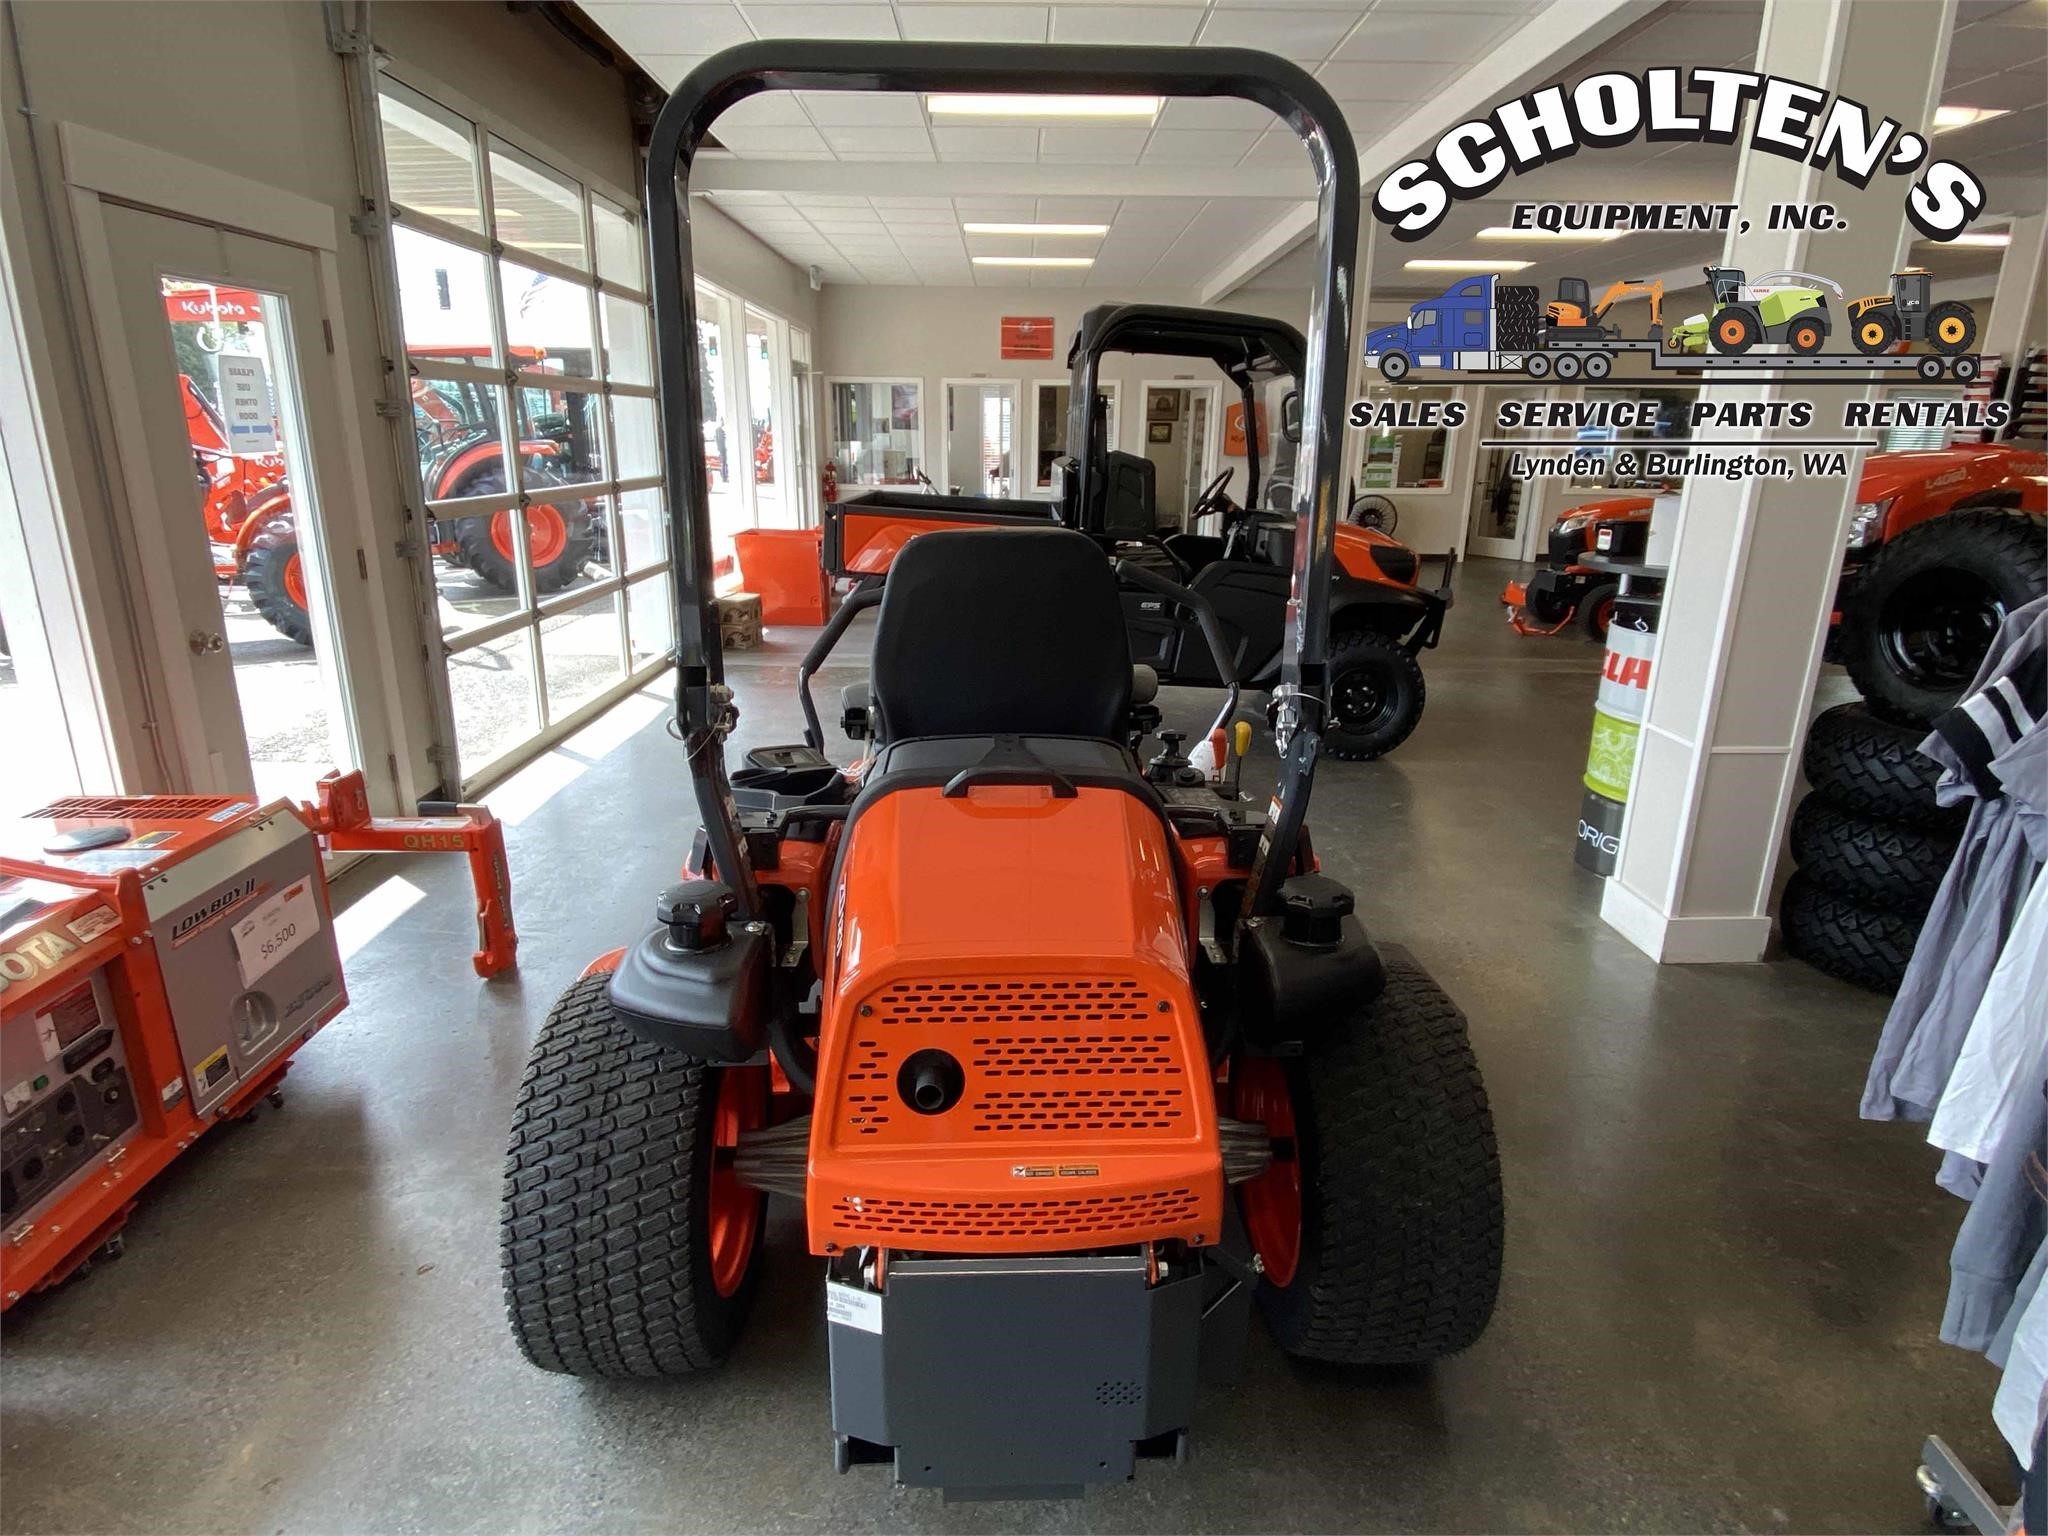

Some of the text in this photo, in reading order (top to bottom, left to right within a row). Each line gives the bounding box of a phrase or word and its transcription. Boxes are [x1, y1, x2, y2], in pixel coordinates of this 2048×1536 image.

[404, 834, 465, 849] QH15
[1578, 819, 1621, 854] ORIG
[260, 922, 297, 960] $6,500
[0, 930, 80, 993] OTA
